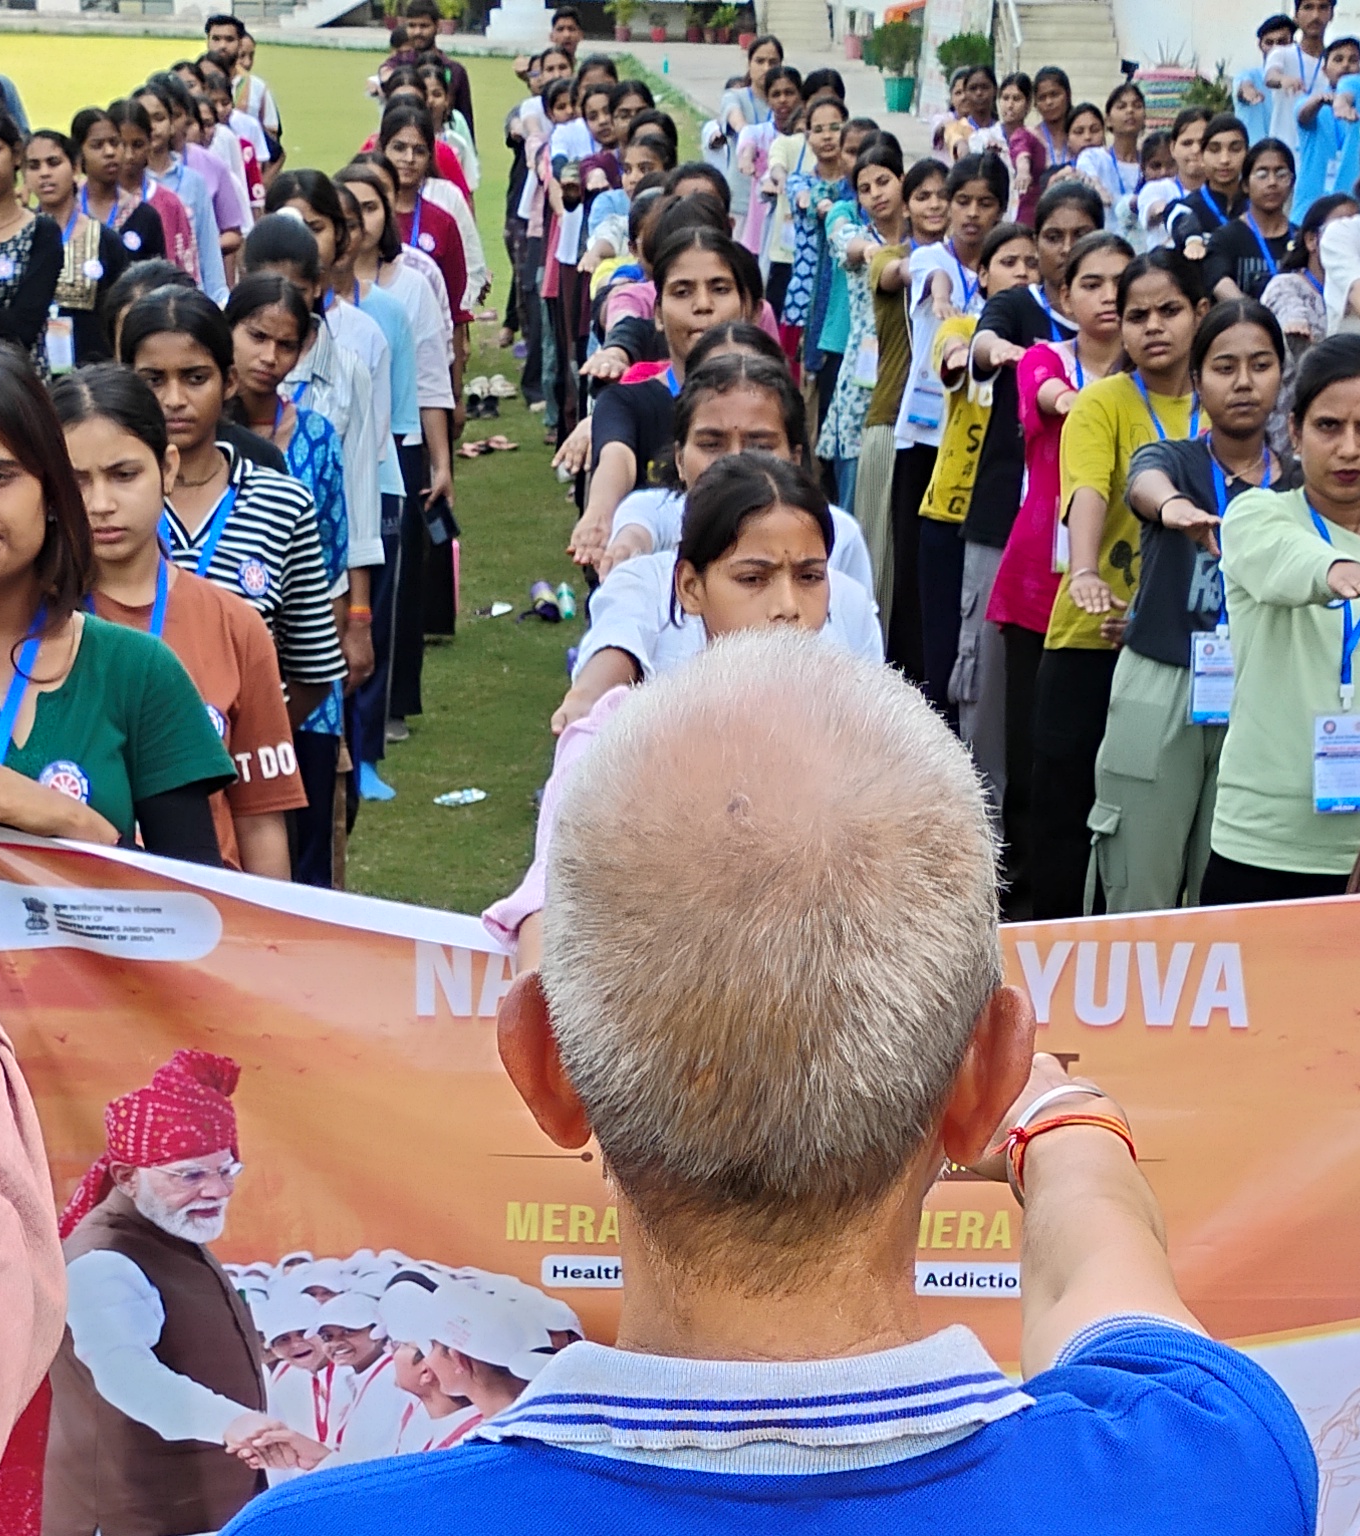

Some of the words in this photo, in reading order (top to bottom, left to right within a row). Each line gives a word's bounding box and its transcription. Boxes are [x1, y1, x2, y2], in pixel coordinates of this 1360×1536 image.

[258, 741, 297, 780] DO
[1015, 940, 1250, 1030] YUVA
[923, 1272, 1022, 1290] Addictio
